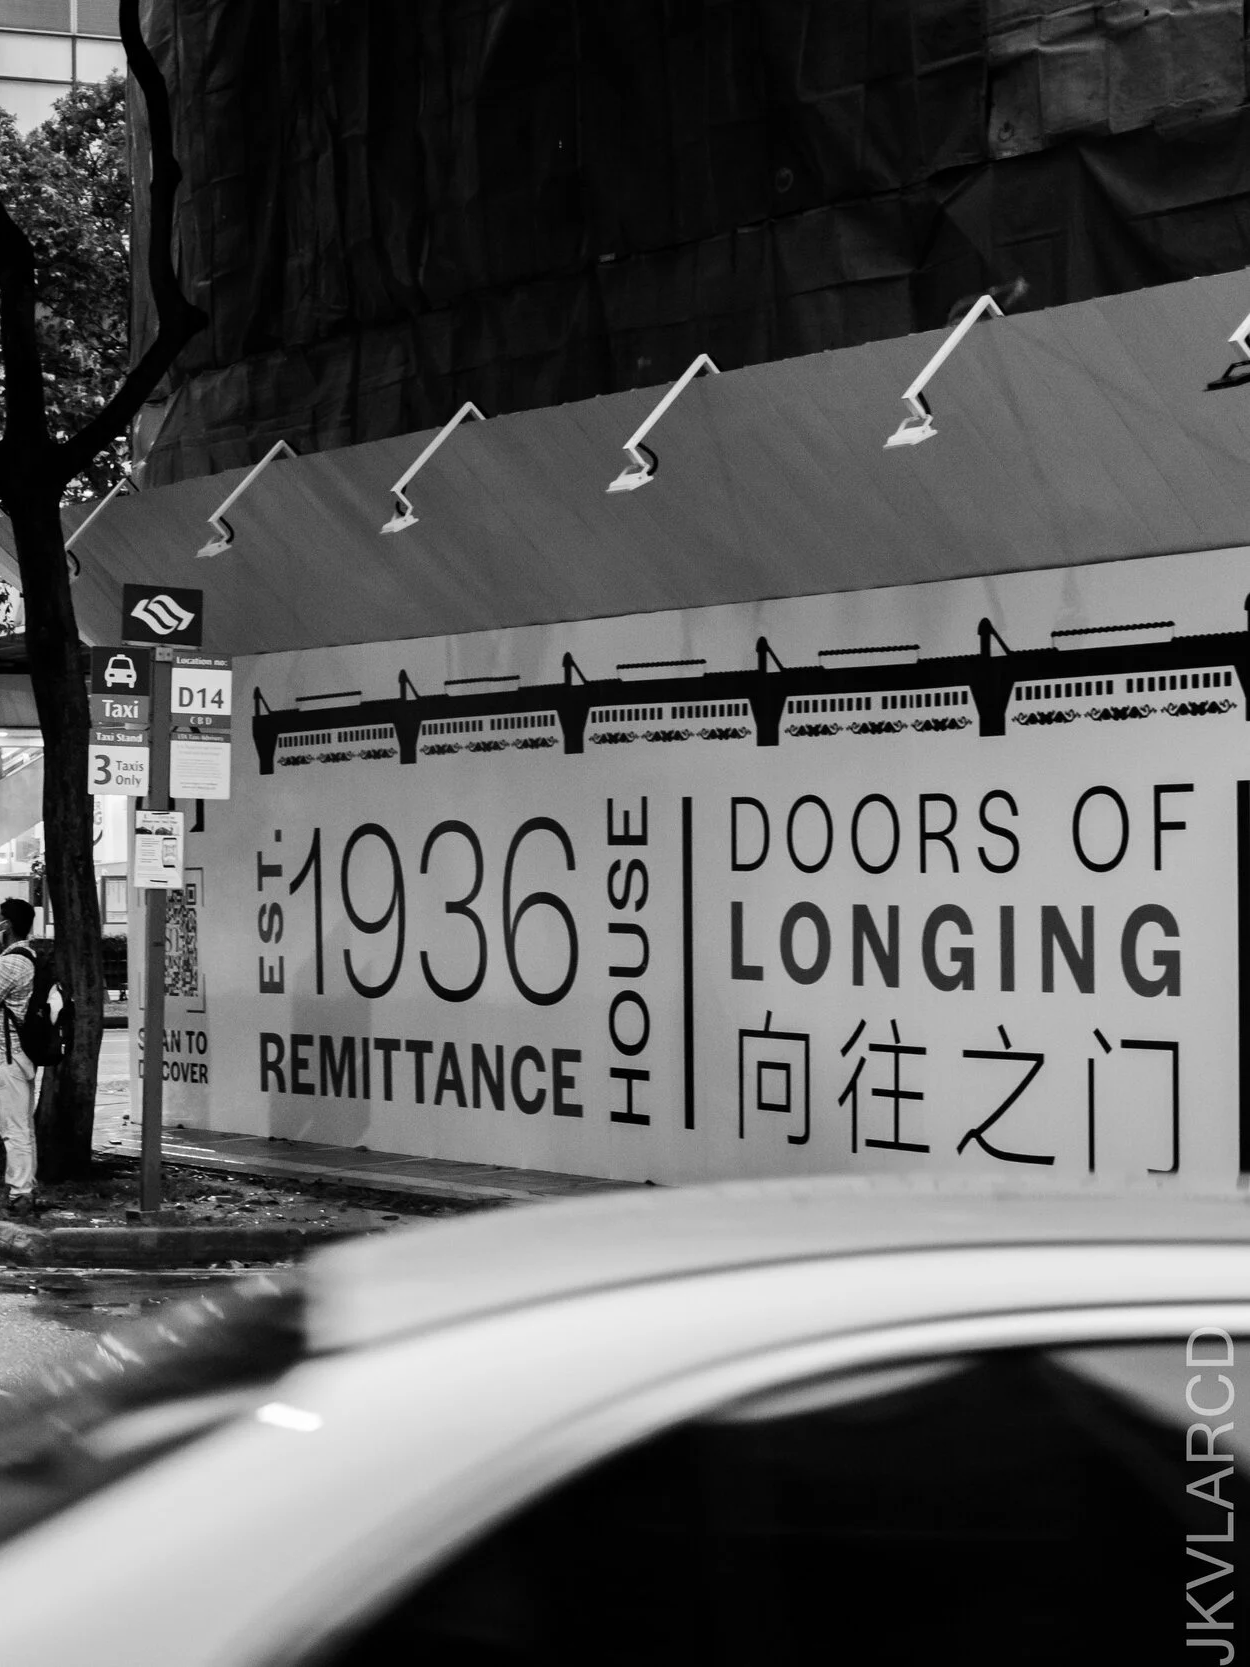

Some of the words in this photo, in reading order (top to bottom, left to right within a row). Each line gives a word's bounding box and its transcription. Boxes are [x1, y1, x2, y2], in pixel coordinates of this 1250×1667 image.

[101, 699, 139, 719] Taxi
[178, 686, 224, 709] D14
[96, 732, 114, 741] Taxi
[116, 733, 143, 743] Stand
[115, 760, 144, 772] Taxis
[93, 754, 112, 785] 3
[115, 774, 142, 787] Only
[730, 789, 1020, 875] DOORS
[1072, 783, 1194, 873] OF
[256, 829, 285, 994] EST.
[289, 816, 579, 1007] 1936
[606, 795, 651, 1127] HOUSE
[730, 901, 1181, 998] LONGING
[185, 1030, 208, 1055] TO
[259, 1032, 584, 1118] REMITTANCE
[738, 1010, 1180, 1174] 向往之门
